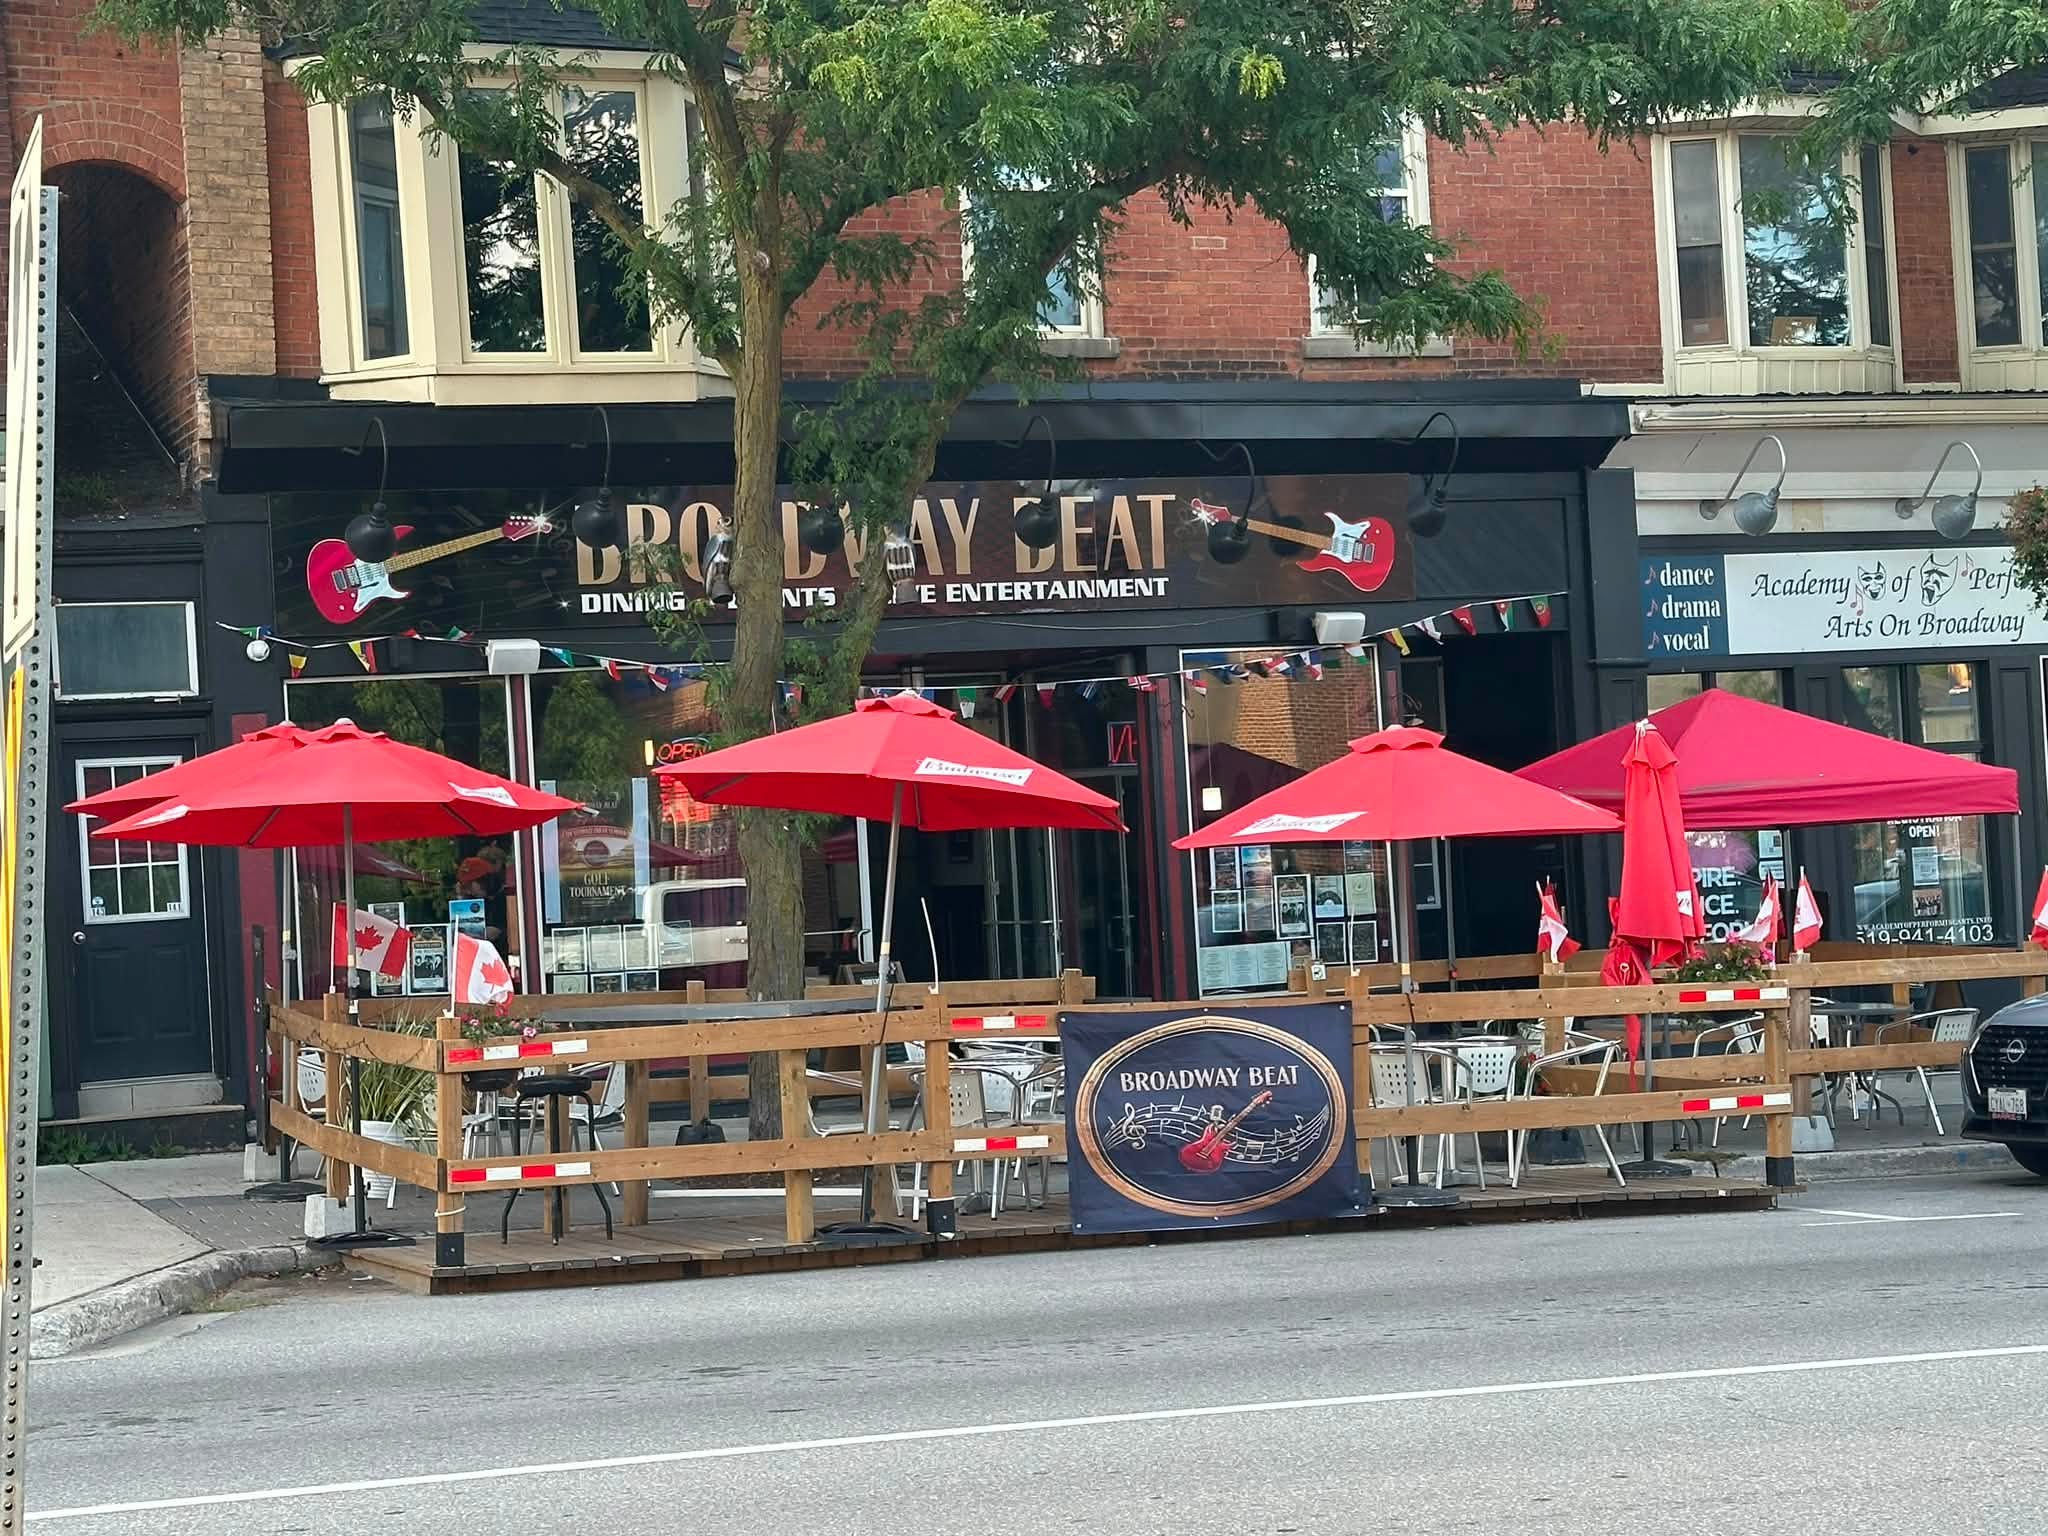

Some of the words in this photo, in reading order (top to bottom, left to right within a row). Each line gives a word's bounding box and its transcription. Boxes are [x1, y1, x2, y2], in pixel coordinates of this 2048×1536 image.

[1660, 562, 1714, 586] dance
[1751, 569, 1851, 604] Academy
[1892, 566, 1916, 603] of
[946, 577, 1169, 604] ENTERTAINMENT
[1662, 594, 1720, 619] drama
[1663, 625, 1710, 651] vocal
[1824, 615, 1873, 638] Arts
[1880, 614, 1911, 637] On
[1918, 608, 2025, 642] Broadway
[1909, 825, 1940, 838] OPEN!
[1120, 1067, 1242, 1092] BROADWAY
[1249, 1065, 1300, 1087] BEAT
